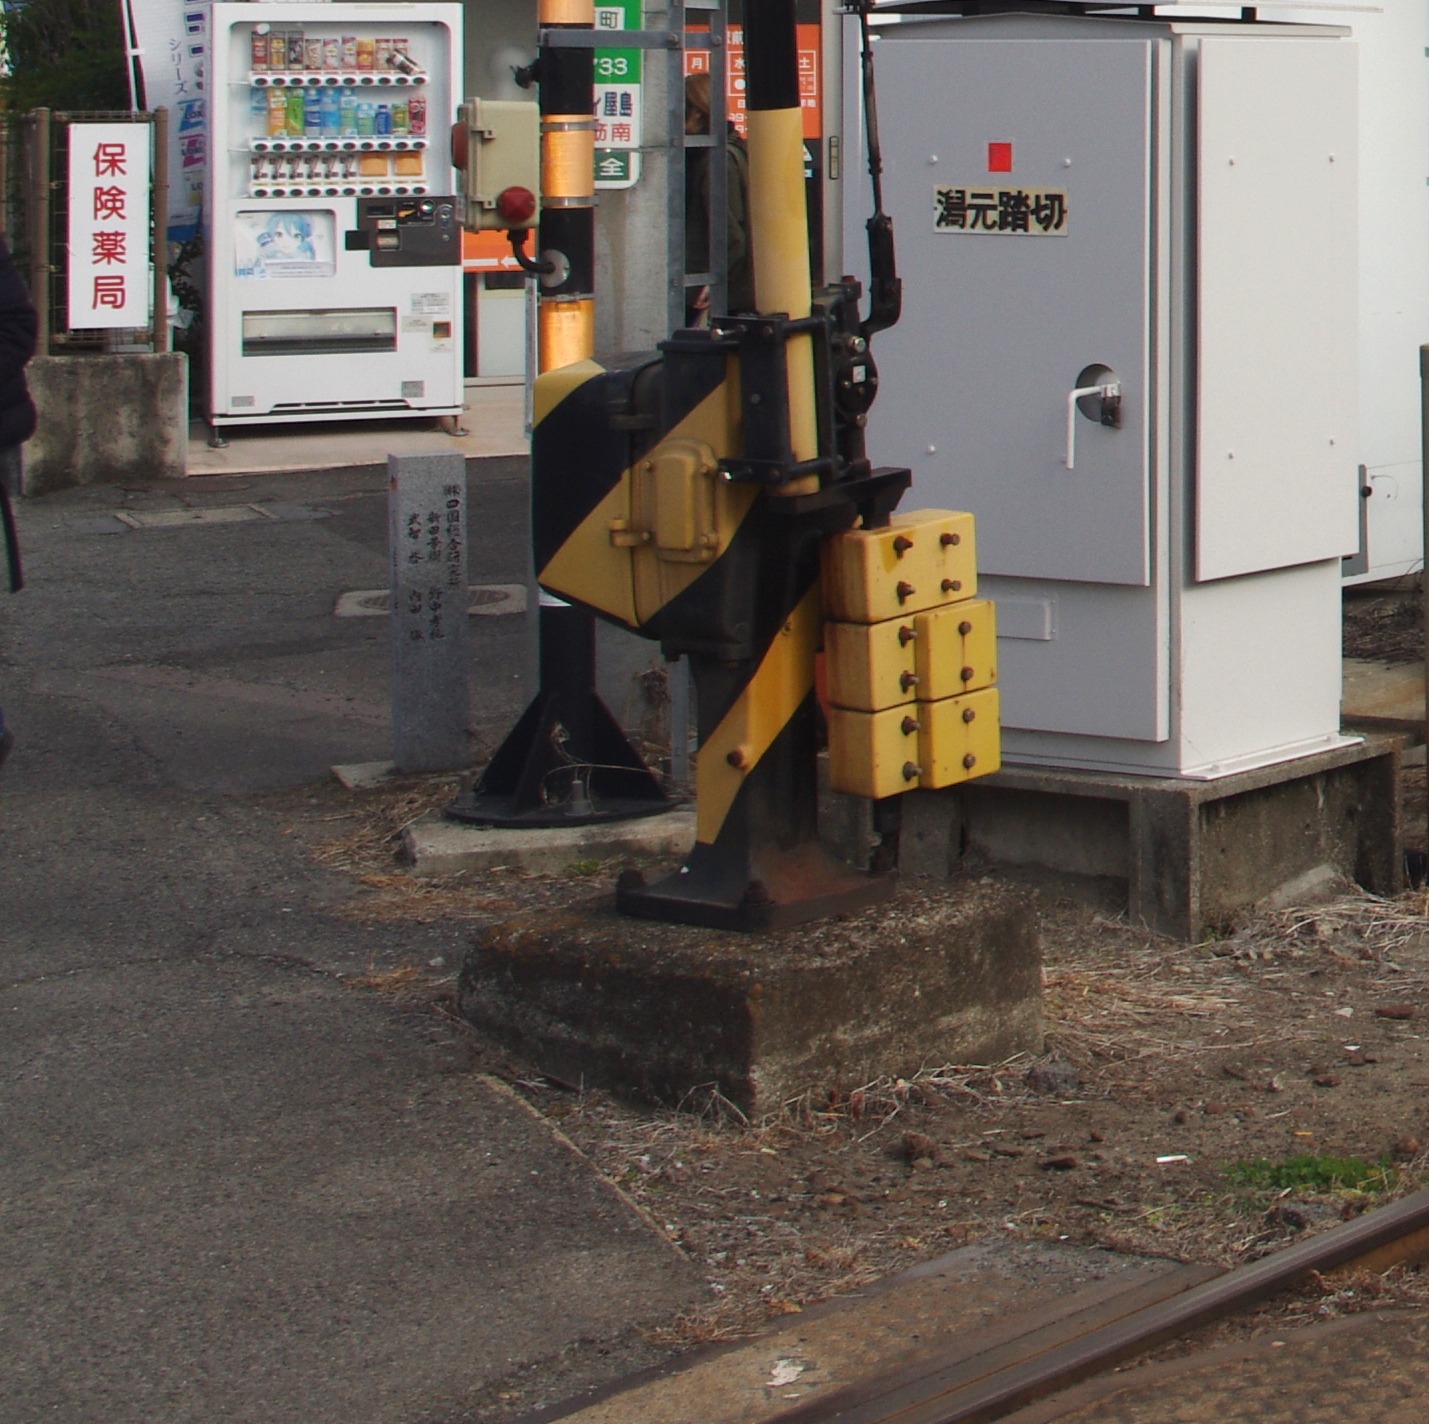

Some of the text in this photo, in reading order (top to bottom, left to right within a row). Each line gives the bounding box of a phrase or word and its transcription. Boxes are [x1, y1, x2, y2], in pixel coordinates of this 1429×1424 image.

[594, 58, 628, 75] 33
[692, 57, 703, 70] 月
[936, 189, 1065, 232] 潟元踏切
[92, 142, 127, 310] 保険薬局
